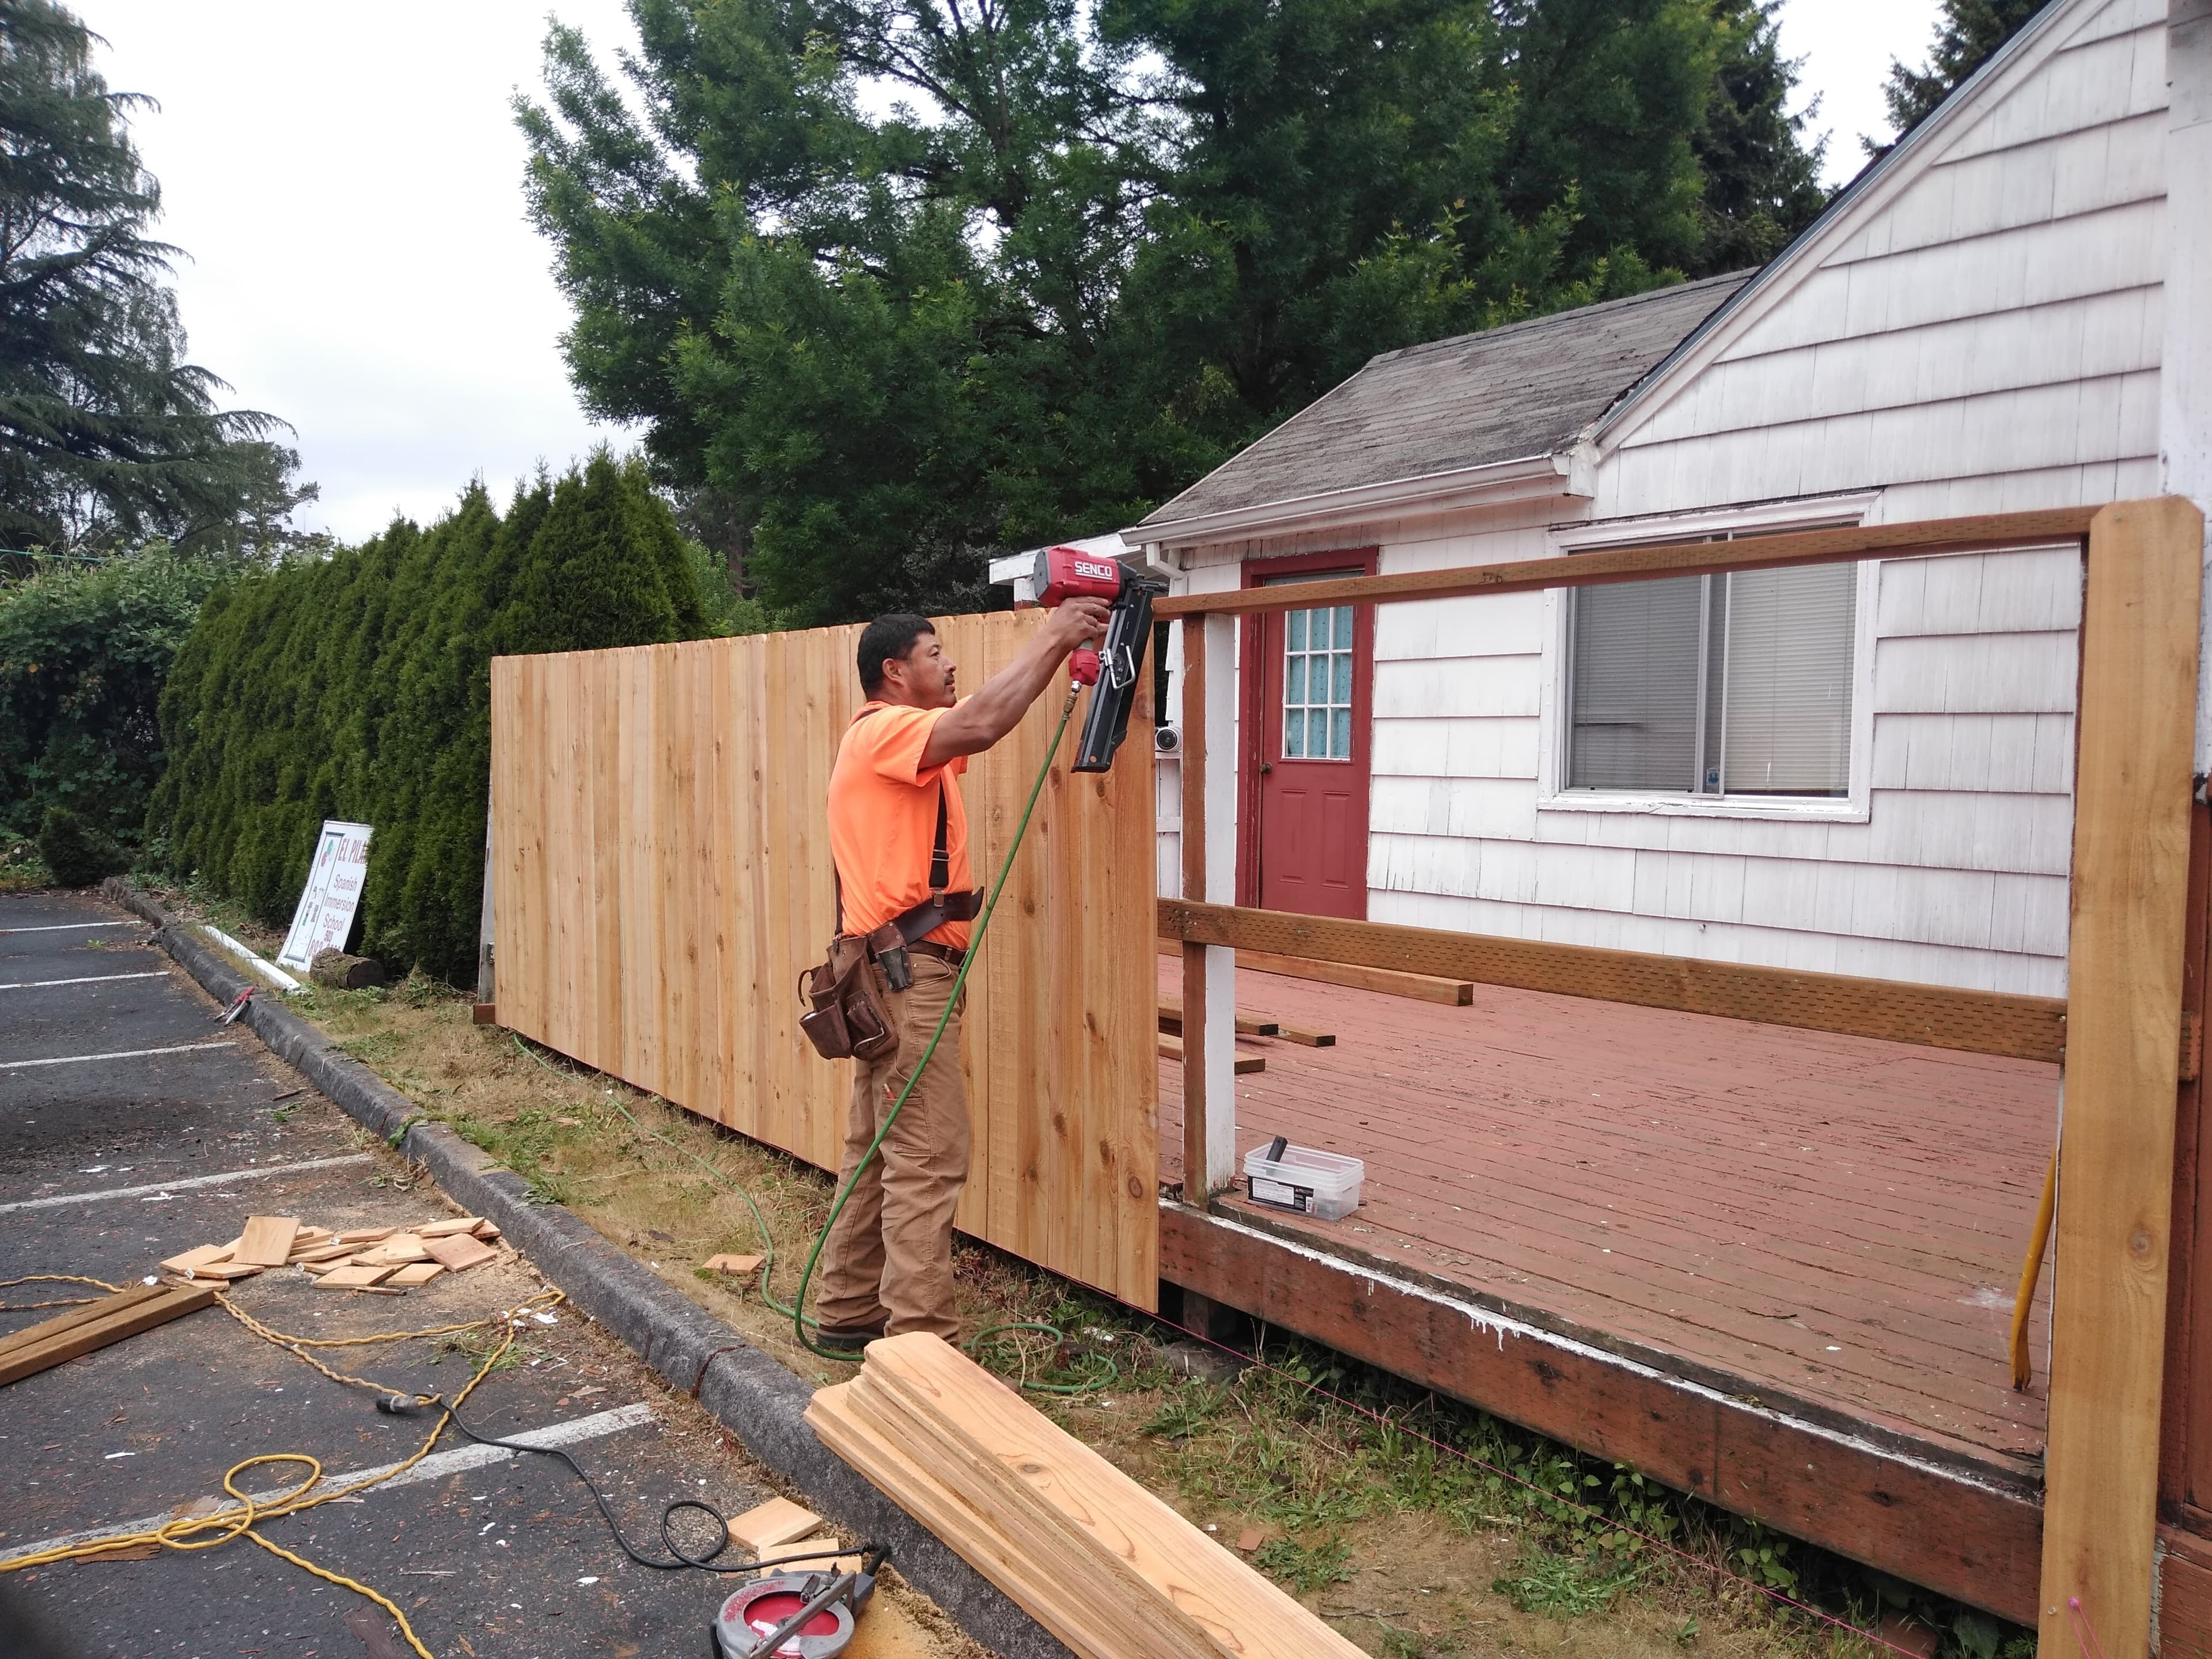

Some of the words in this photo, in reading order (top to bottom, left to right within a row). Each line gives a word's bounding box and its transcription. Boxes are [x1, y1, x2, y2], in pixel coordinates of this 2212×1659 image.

[1074, 561, 1113, 577] SENCO
[338, 838, 350, 862] EL
[348, 839, 366, 864] PILA
[334, 874, 358, 892] Spanish
[324, 893, 355, 913] Immersion
[323, 913, 346, 931] School
